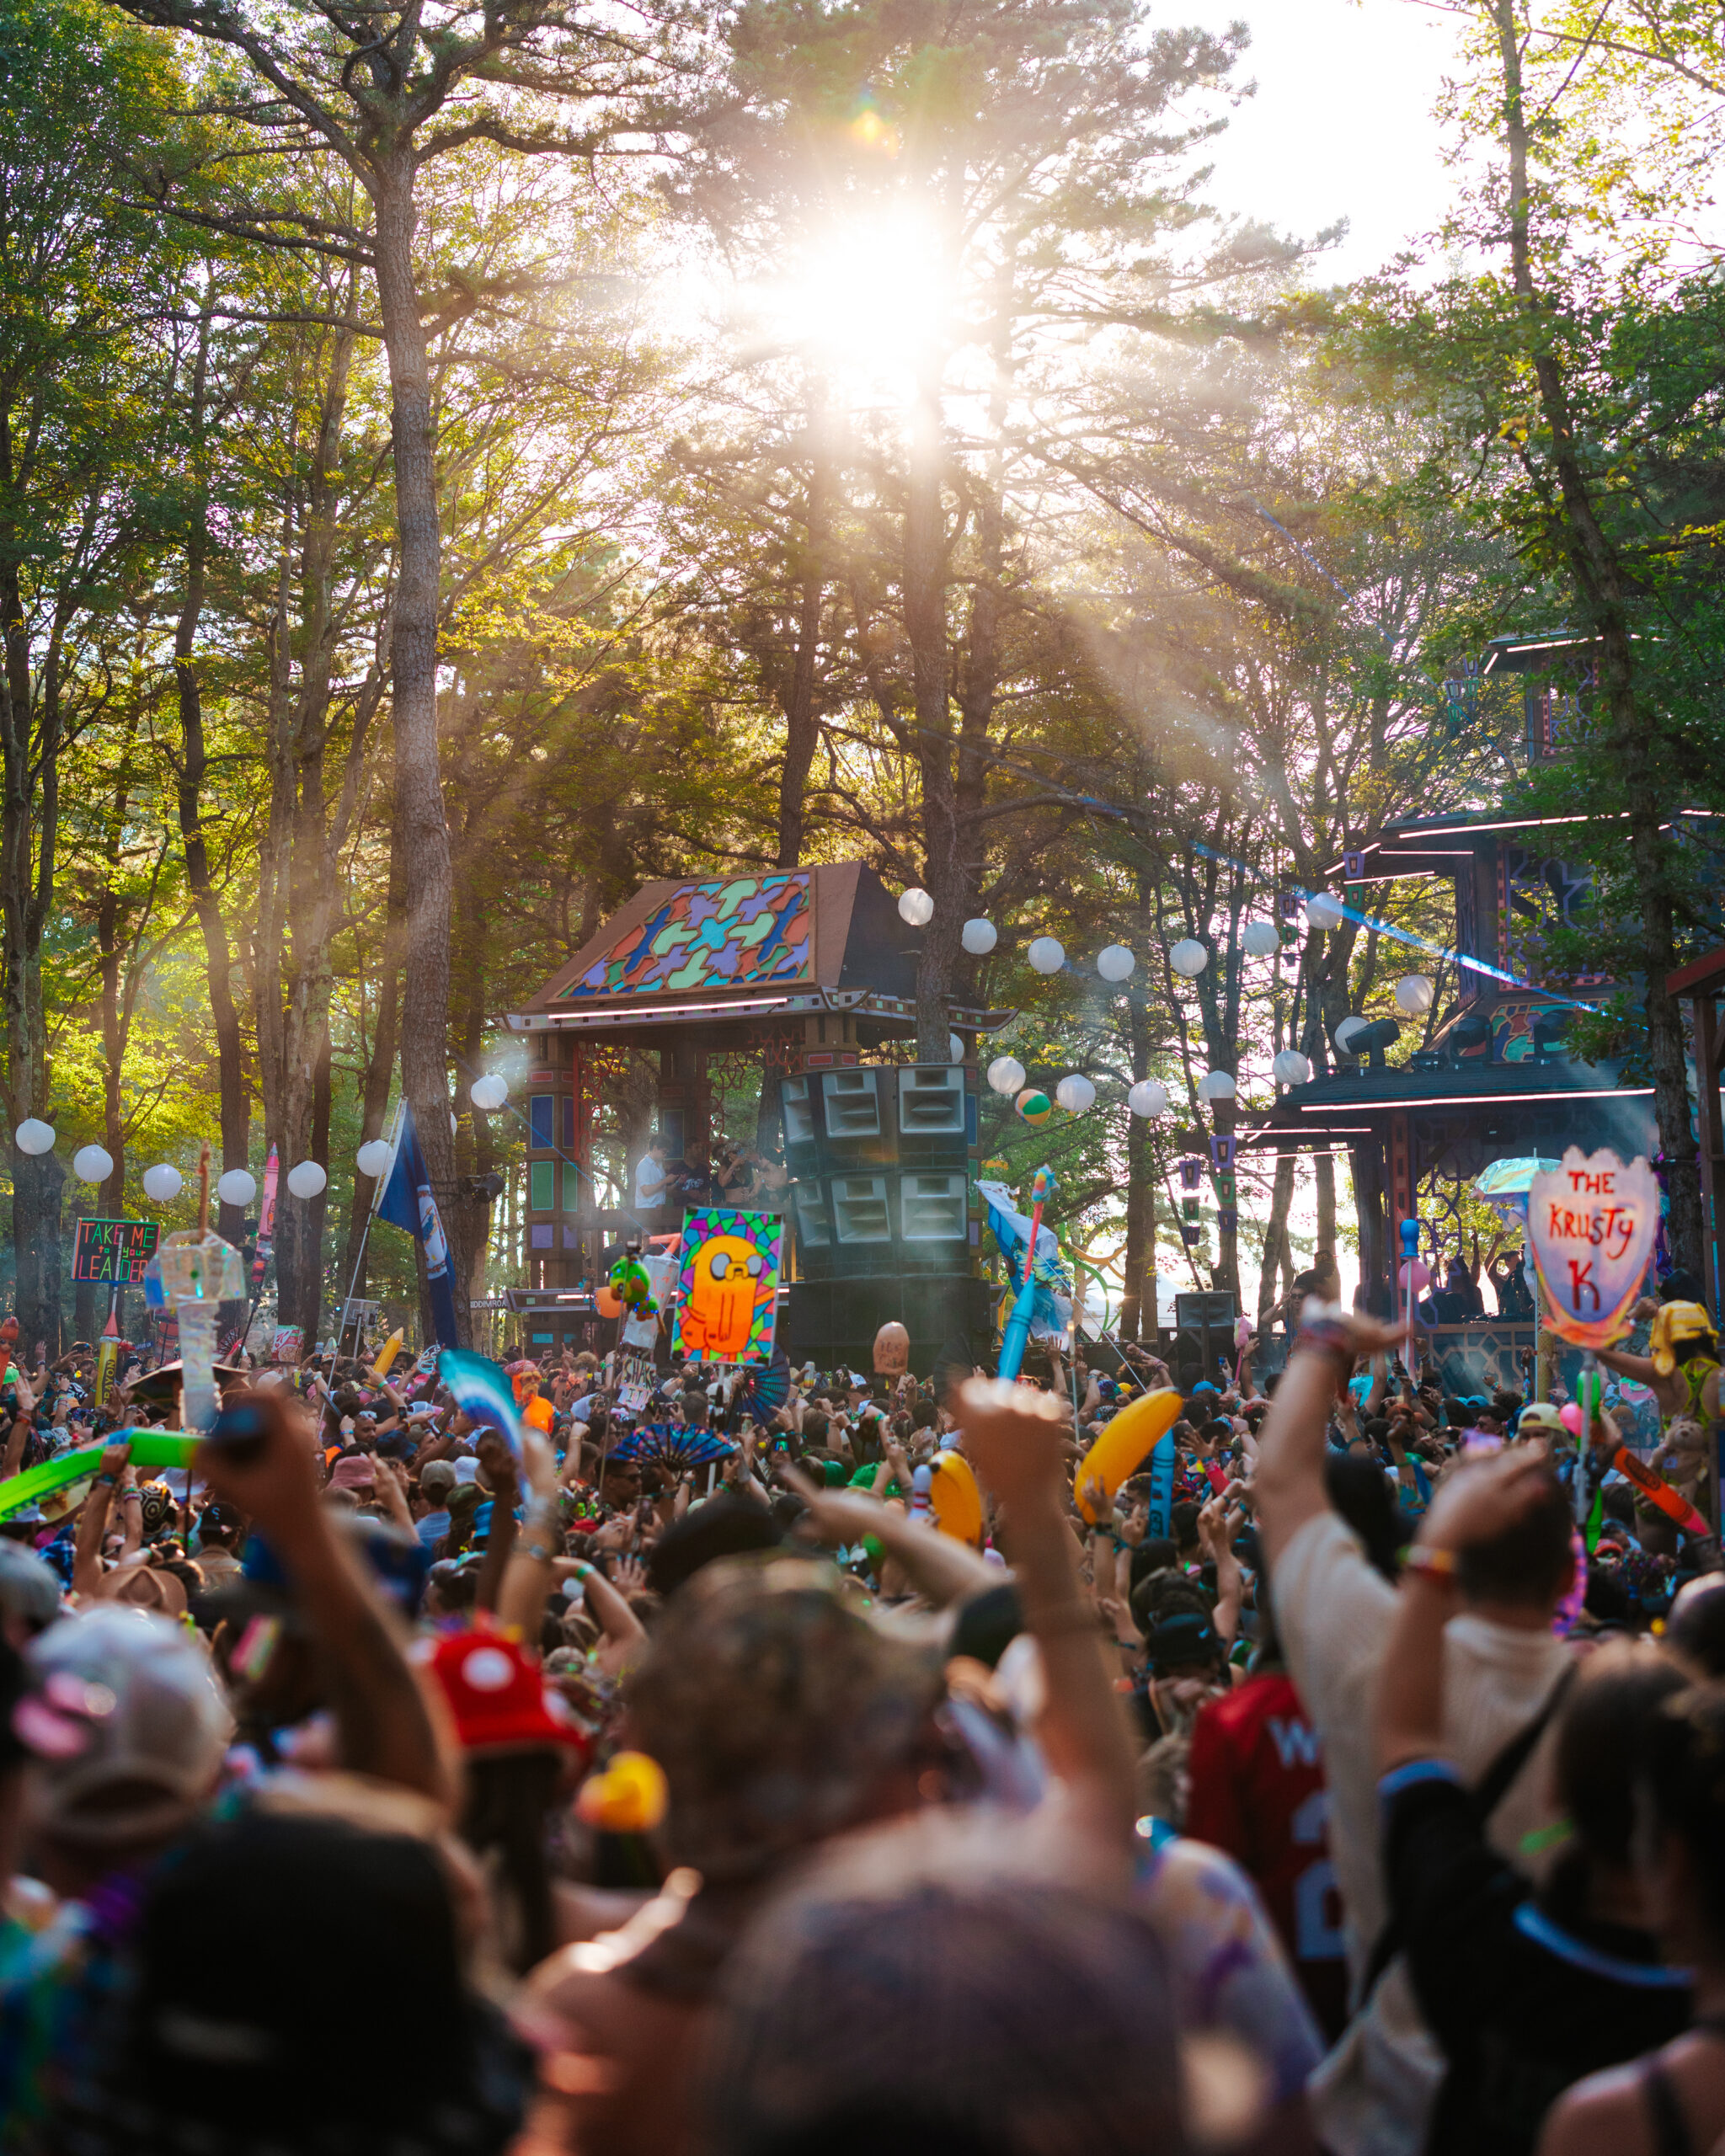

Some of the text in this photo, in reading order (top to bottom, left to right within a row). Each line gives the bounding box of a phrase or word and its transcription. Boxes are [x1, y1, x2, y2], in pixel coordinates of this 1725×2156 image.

[1567, 1170, 1616, 1194] THE
[82, 1223, 155, 1248] TAKE ME
[99, 1245, 146, 1258] to your
[78, 1255, 147, 1283] LEADER
[1567, 1260, 1600, 1310] K
